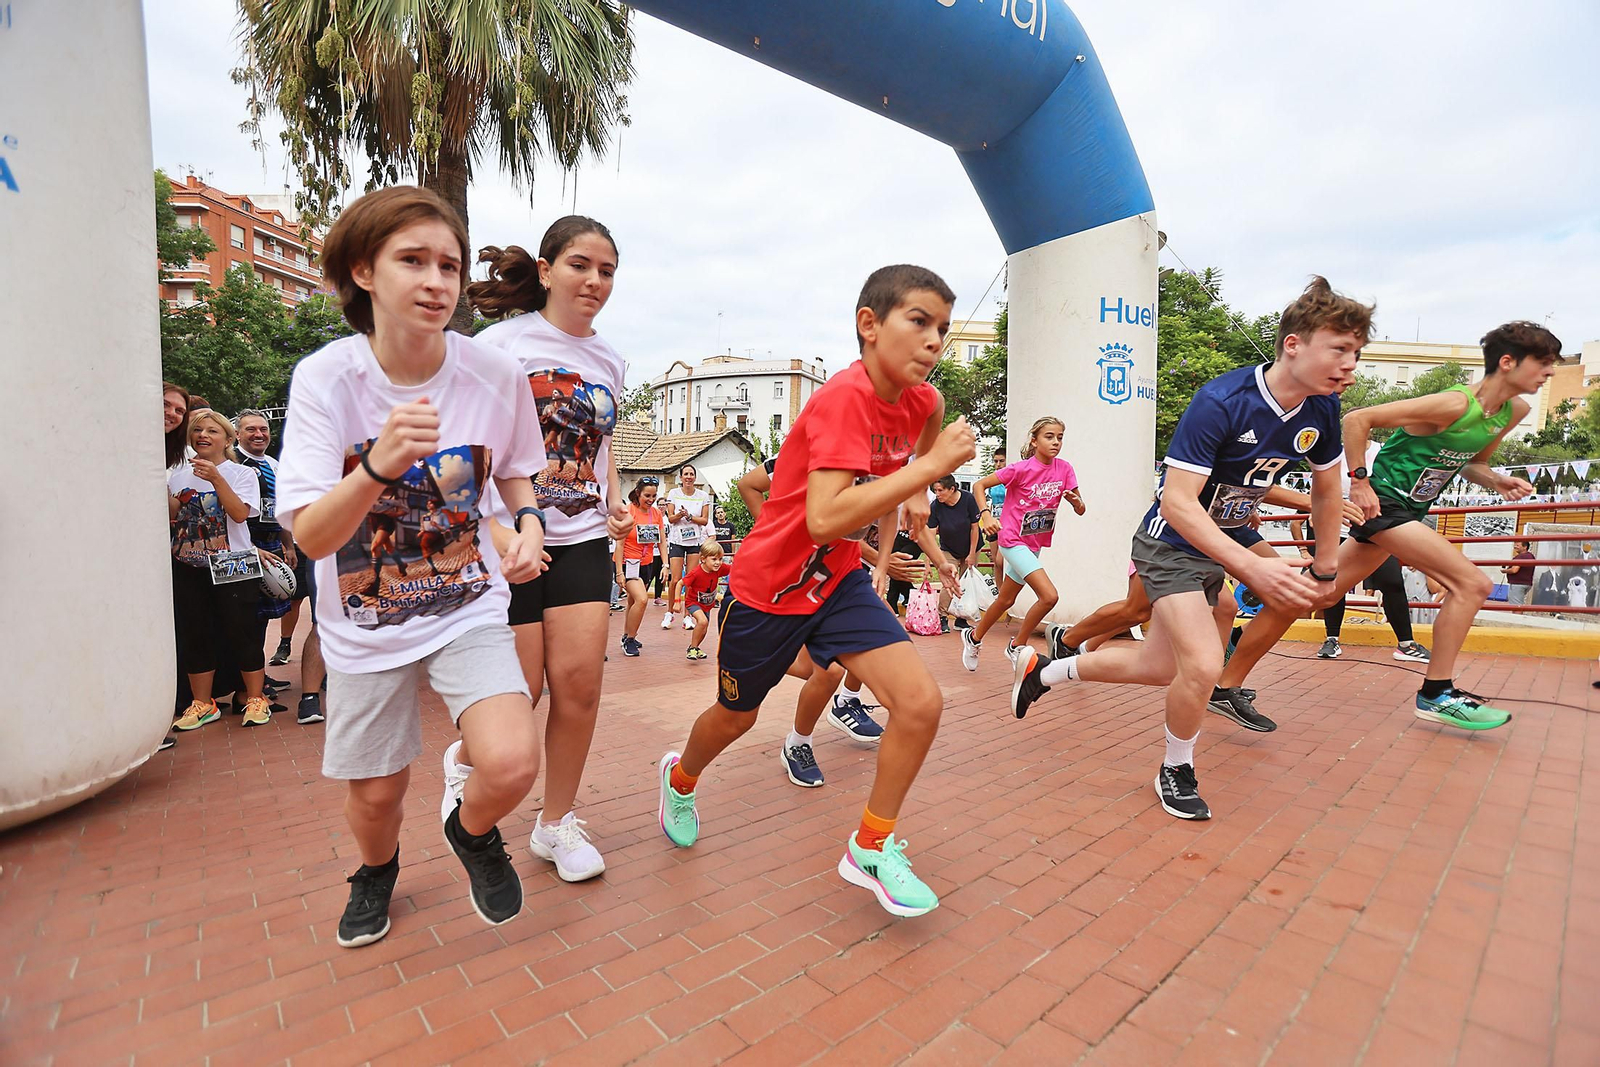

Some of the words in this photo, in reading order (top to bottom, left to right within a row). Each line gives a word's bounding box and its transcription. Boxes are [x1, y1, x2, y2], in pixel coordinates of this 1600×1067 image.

[1099, 297, 1157, 330] Huel
[1236, 436, 1259, 445] adidas
[1243, 458, 1289, 488] 19
[1221, 499, 1254, 520] 15
[1030, 515, 1046, 530] 61
[224, 558, 249, 577] 74
[390, 585, 395, 595] I
[400, 576, 444, 594] MILLA
[379, 583, 463, 609] BRITÁNICA
